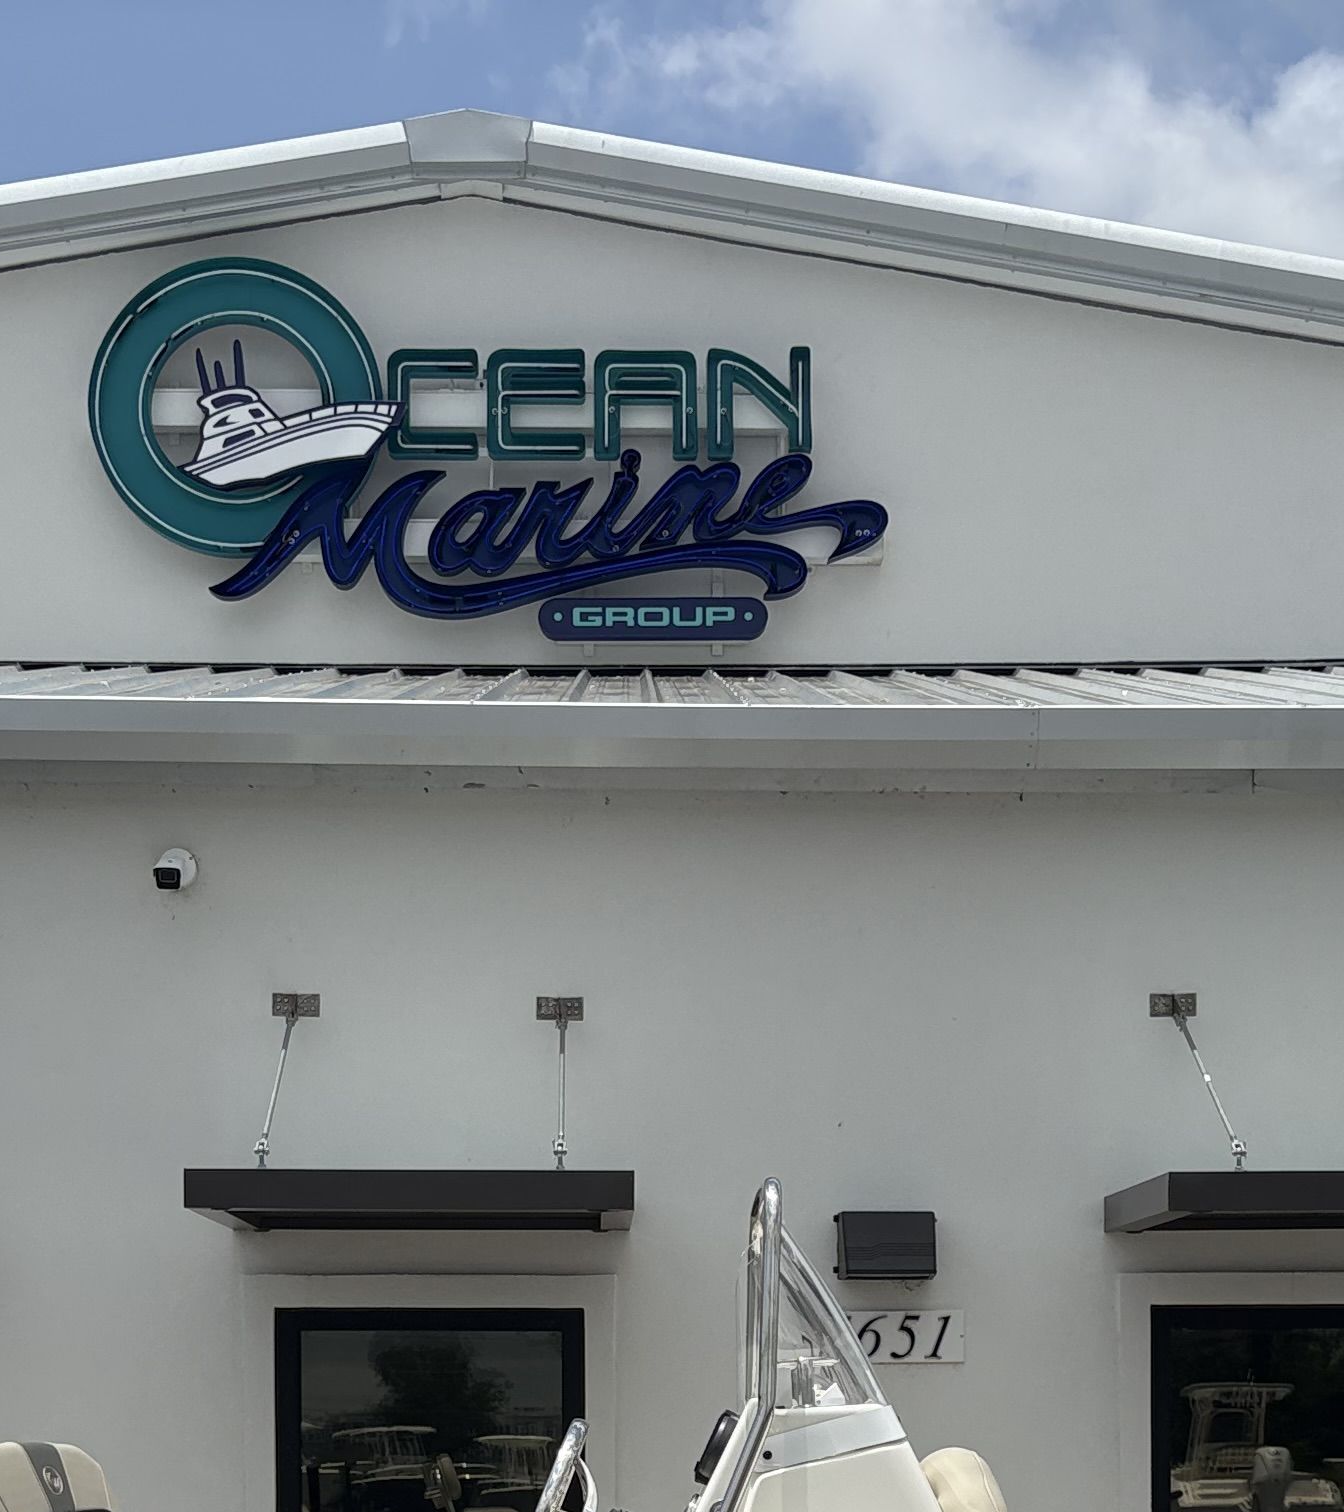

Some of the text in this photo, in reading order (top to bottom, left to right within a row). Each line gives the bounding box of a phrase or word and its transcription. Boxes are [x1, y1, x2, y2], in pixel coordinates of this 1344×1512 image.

[89, 257, 813, 559] OCEAN
[208, 449, 889, 620] Marine
[572, 604, 737, 629] GROUP
[847, 1314, 951, 1360] 651
